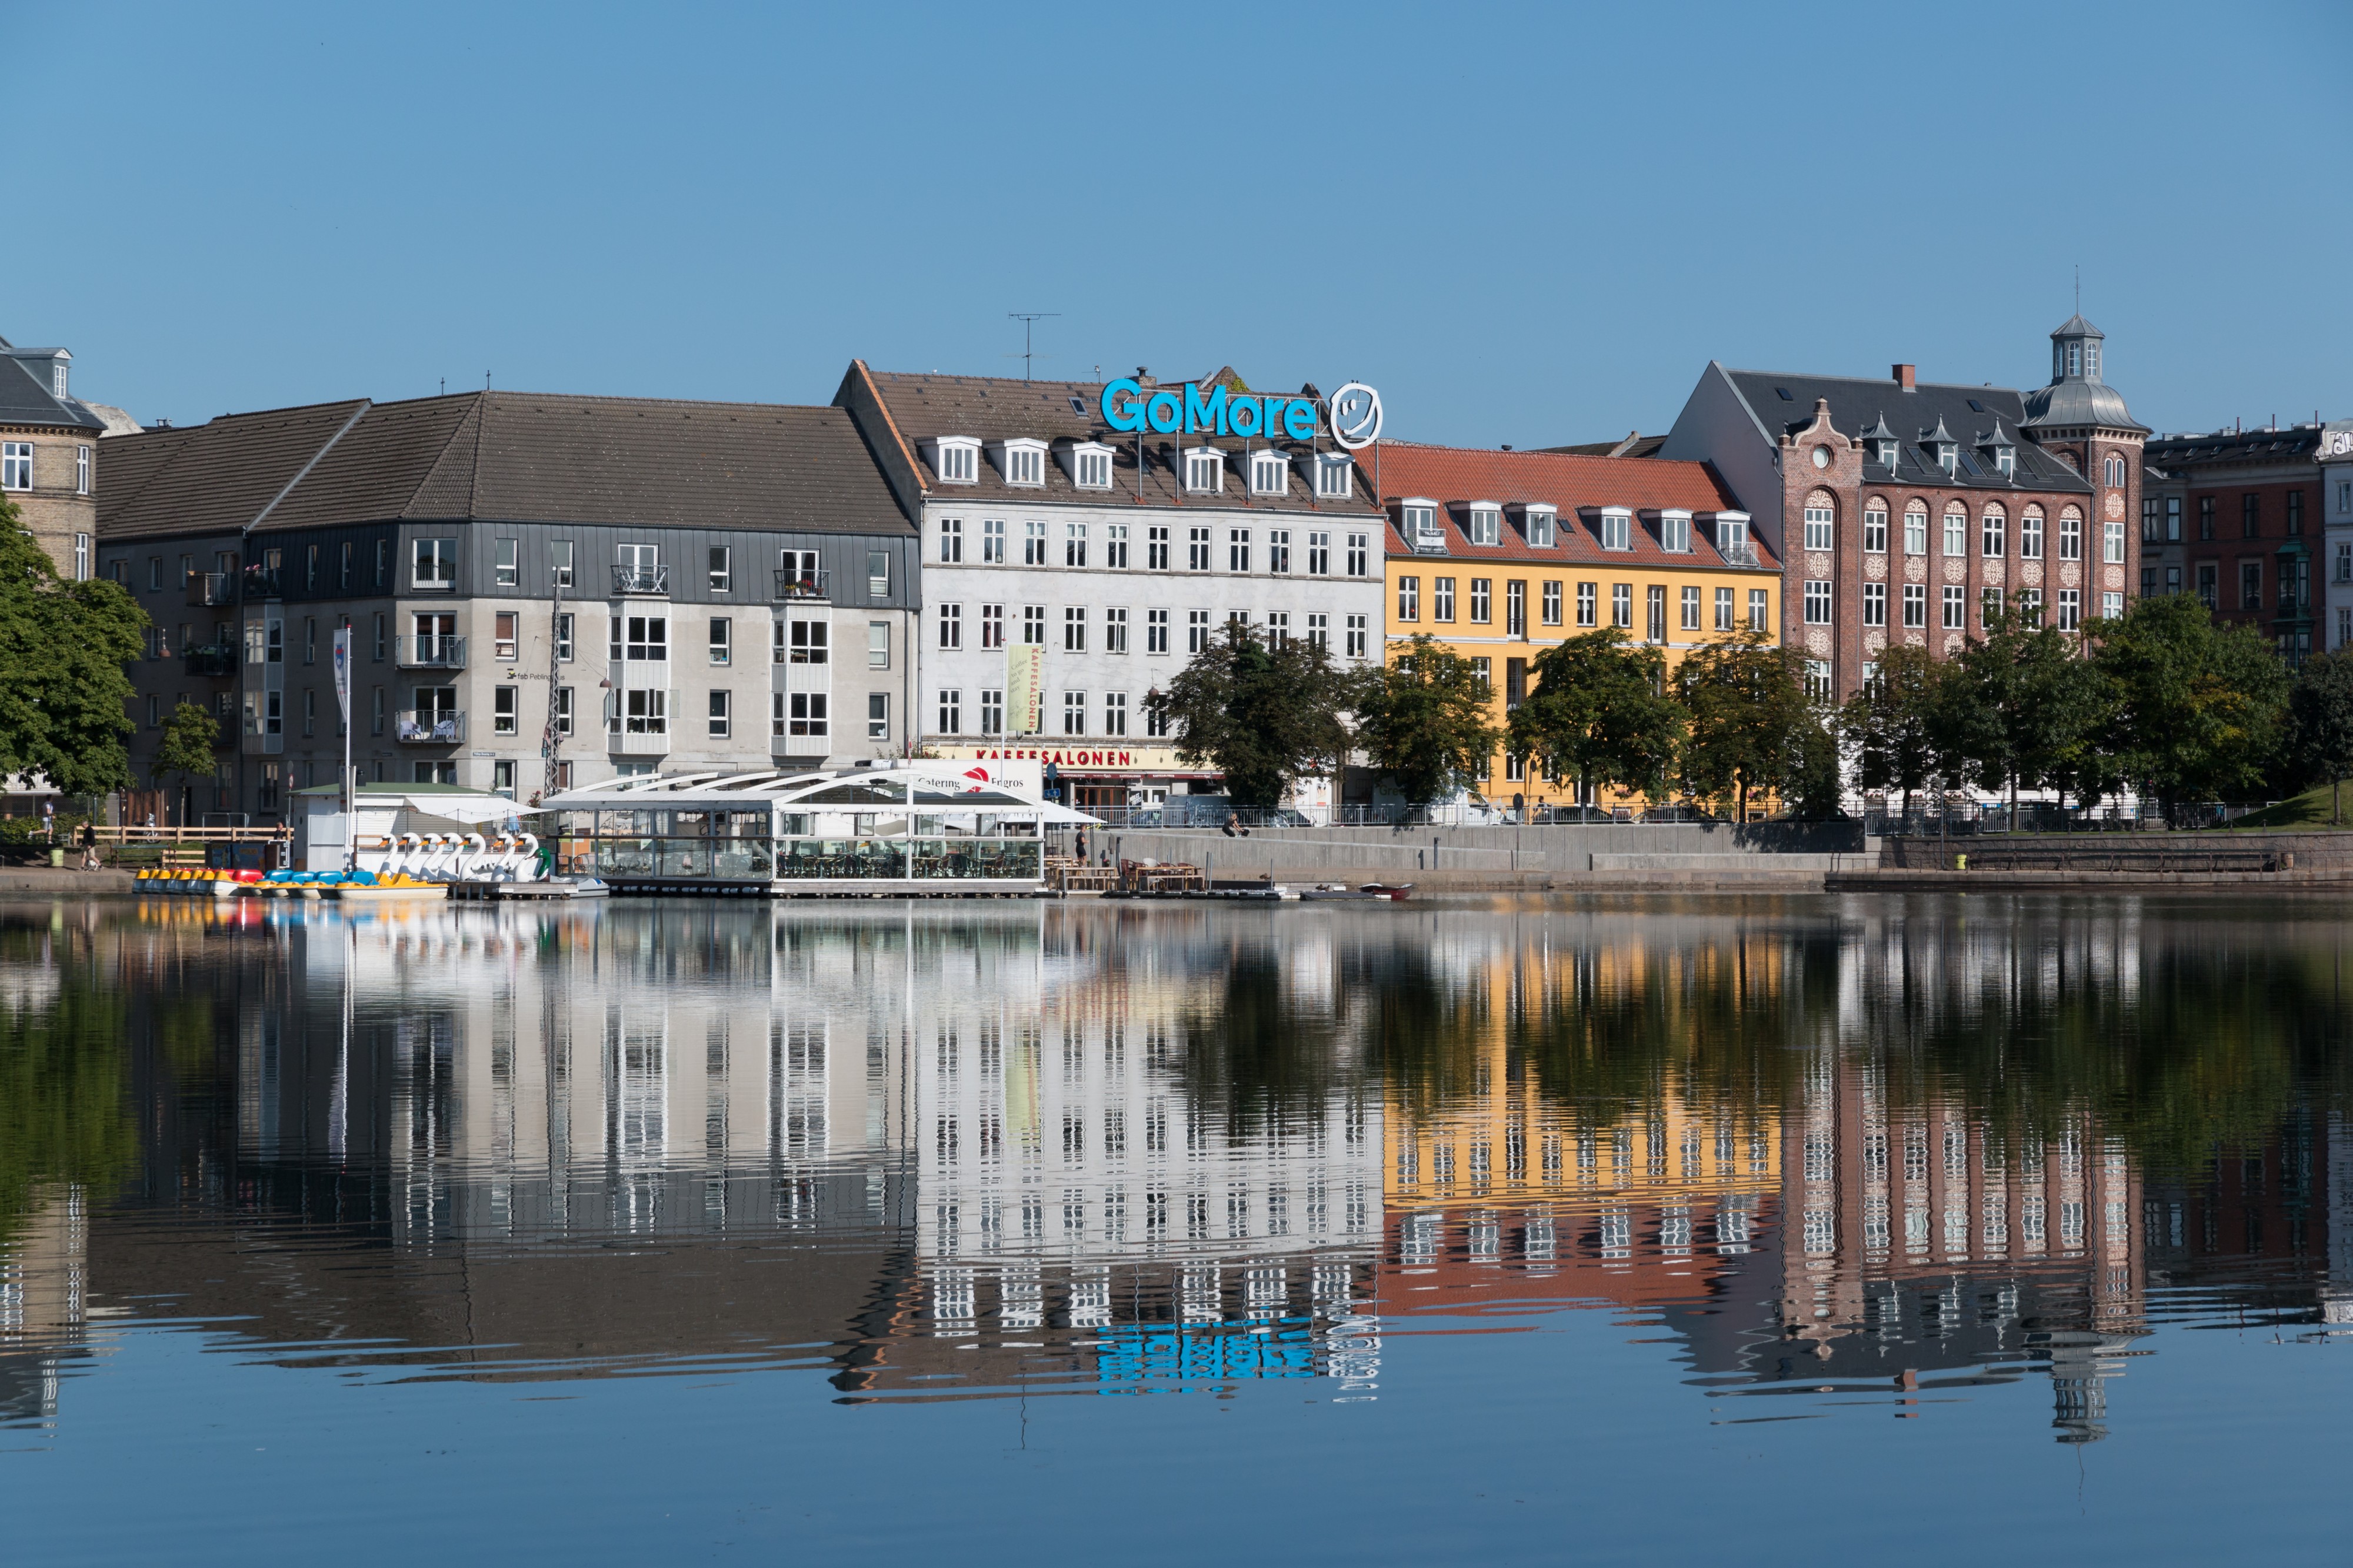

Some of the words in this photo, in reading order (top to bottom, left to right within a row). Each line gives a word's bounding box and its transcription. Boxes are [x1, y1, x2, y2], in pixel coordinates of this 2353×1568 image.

[1100, 378, 1317, 441] GoMore
[1011, 658, 1028, 670] Coffee
[1010, 685, 1021, 693] stay
[1011, 678, 1021, 686] and
[1028, 648, 1039, 728] KAFFESALONEN
[976, 750, 1130, 766] KAFFESALONEN
